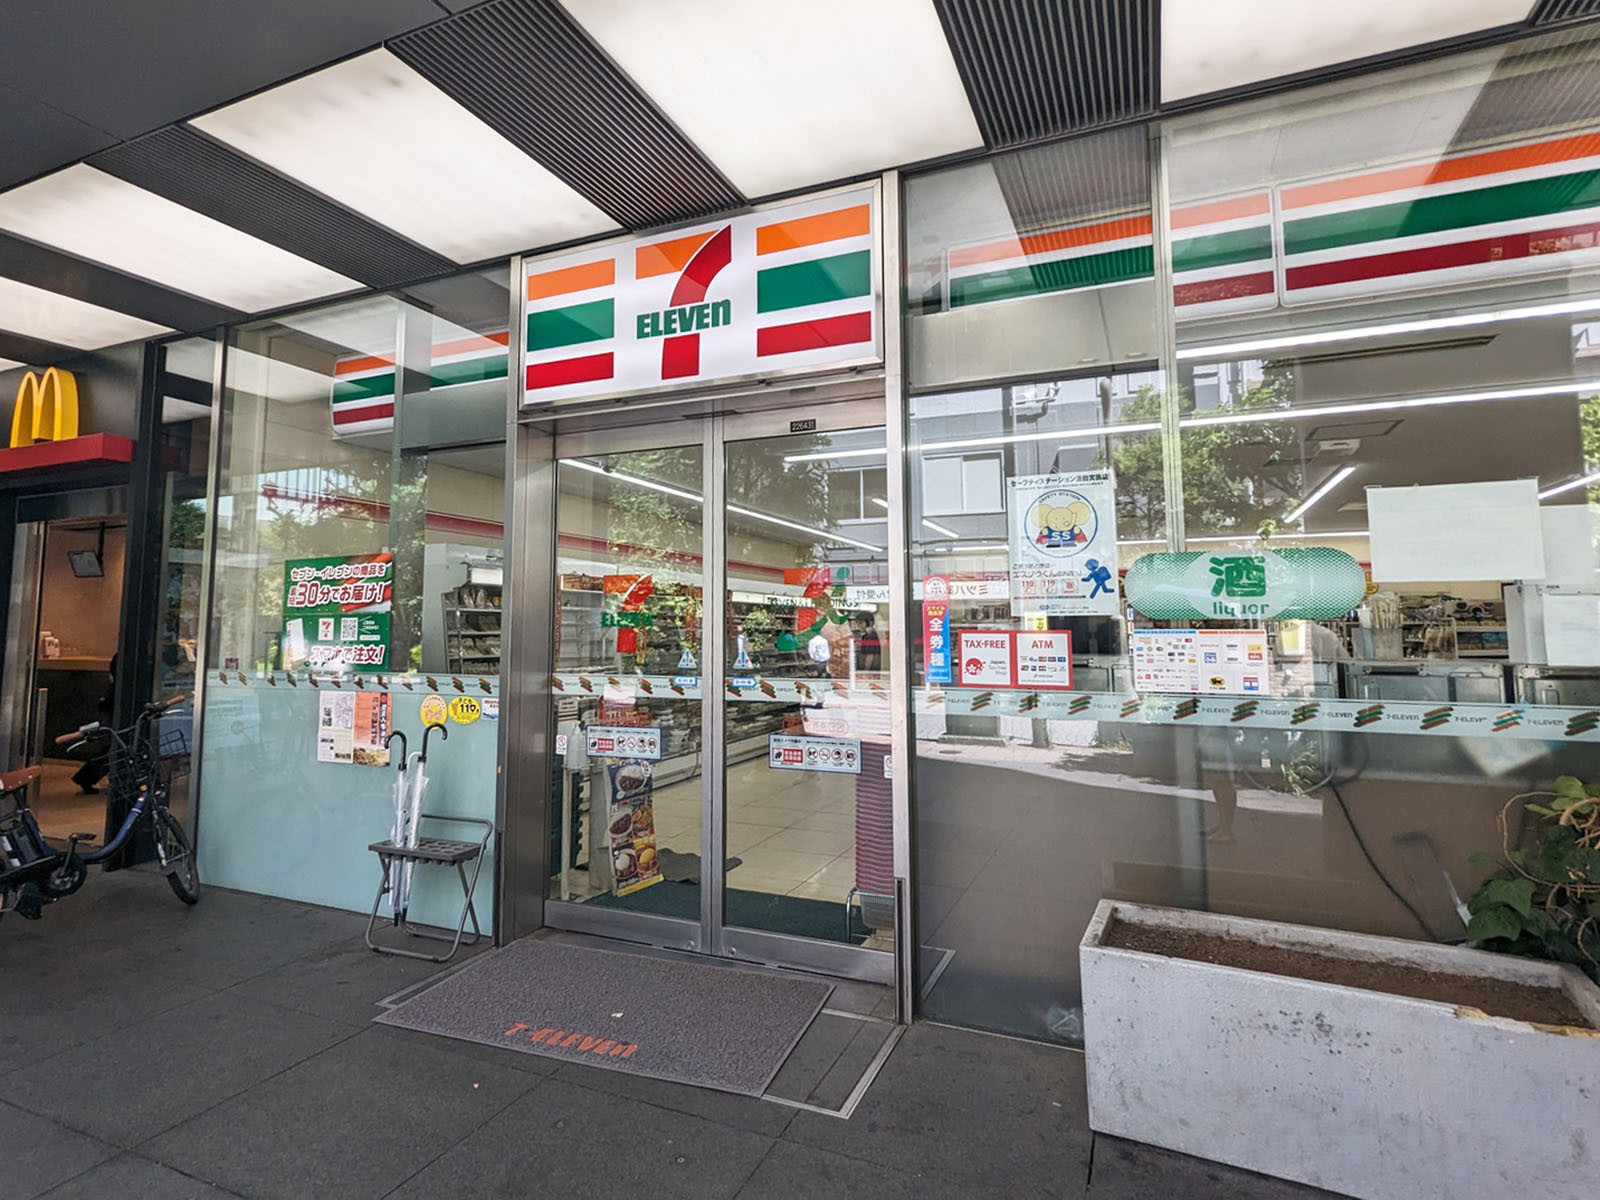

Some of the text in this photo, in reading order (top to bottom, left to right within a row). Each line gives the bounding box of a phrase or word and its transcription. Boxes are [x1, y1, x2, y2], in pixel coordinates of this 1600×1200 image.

[636, 224, 732, 380] 7
[1051, 531, 1071, 541] SS
[1209, 556, 1265, 597] 酒
[1031, 640, 1054, 649] ATM
